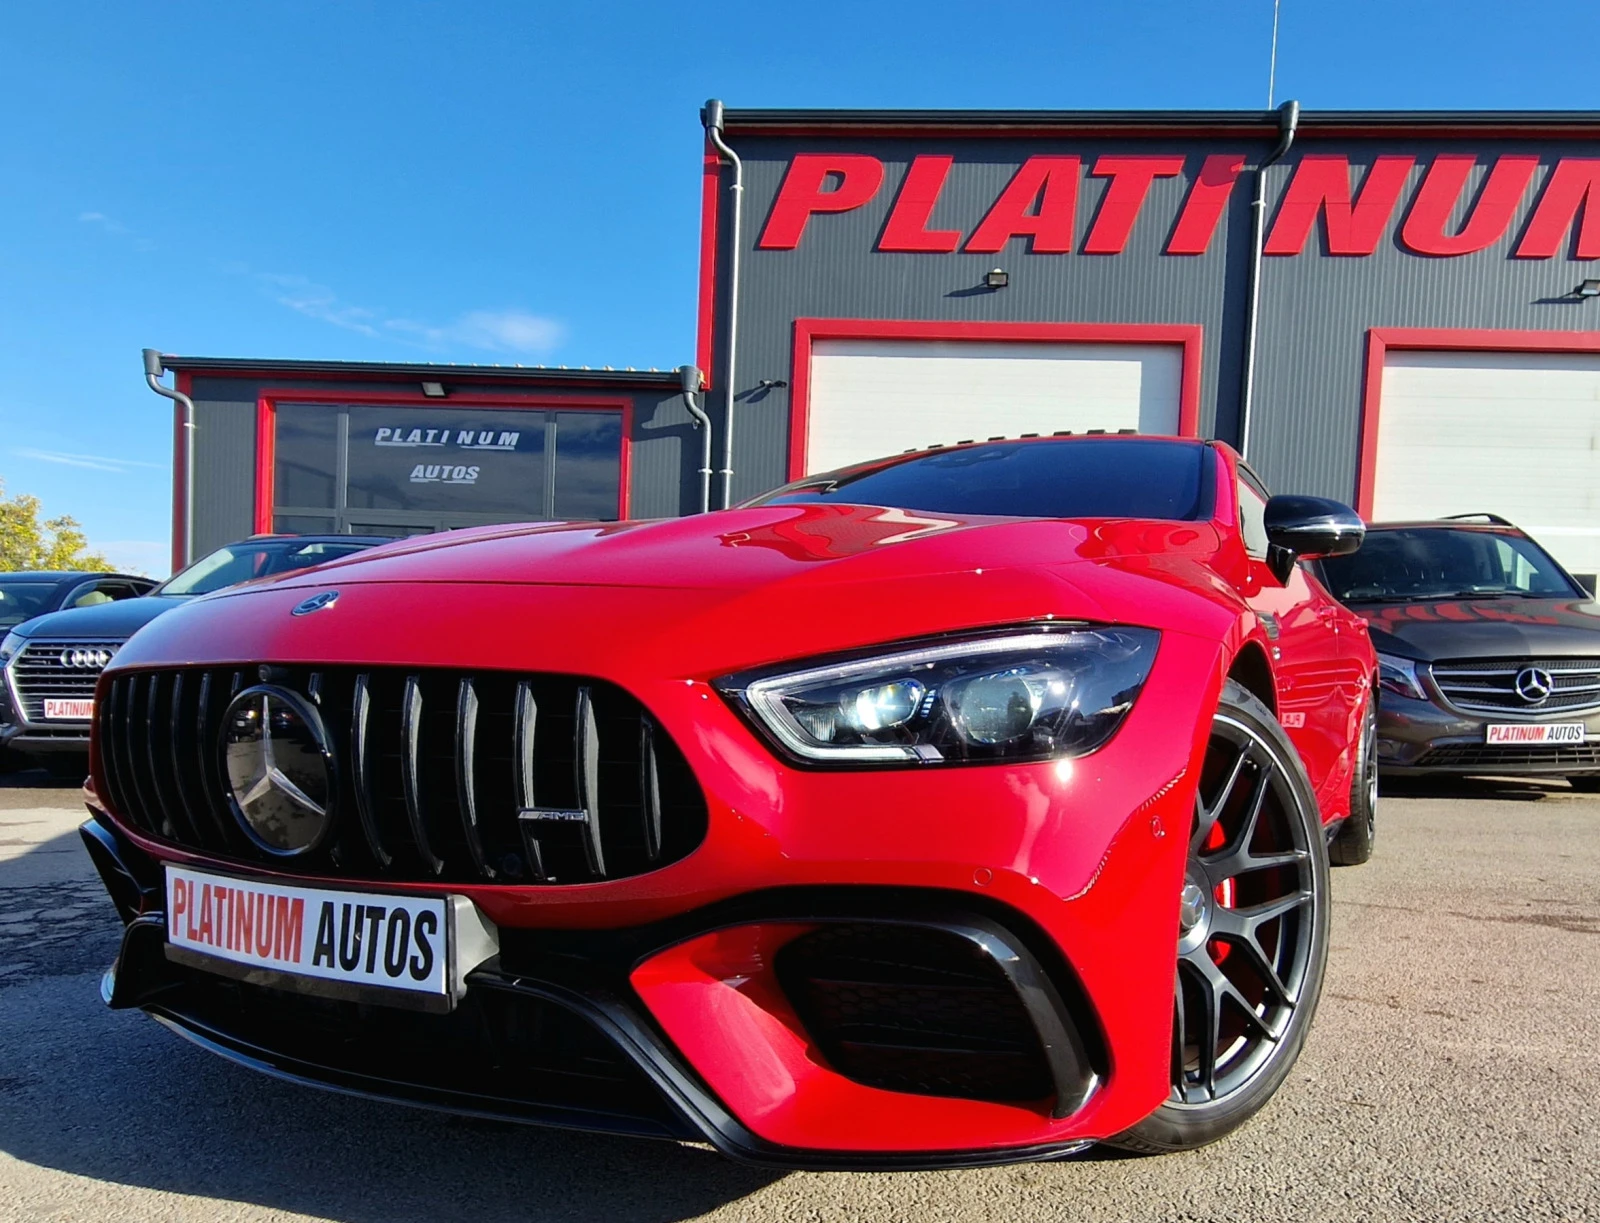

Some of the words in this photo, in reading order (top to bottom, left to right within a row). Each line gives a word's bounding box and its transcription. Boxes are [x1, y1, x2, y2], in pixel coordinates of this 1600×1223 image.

[410, 464, 480, 482] AUTOS
[1490, 727, 1545, 741] PLATINUM
[1547, 726, 1581, 740] AUTOS
[538, 811, 584, 821] AMG
[172, 877, 304, 963] PLATINUM
[312, 901, 438, 981] AUTOS
